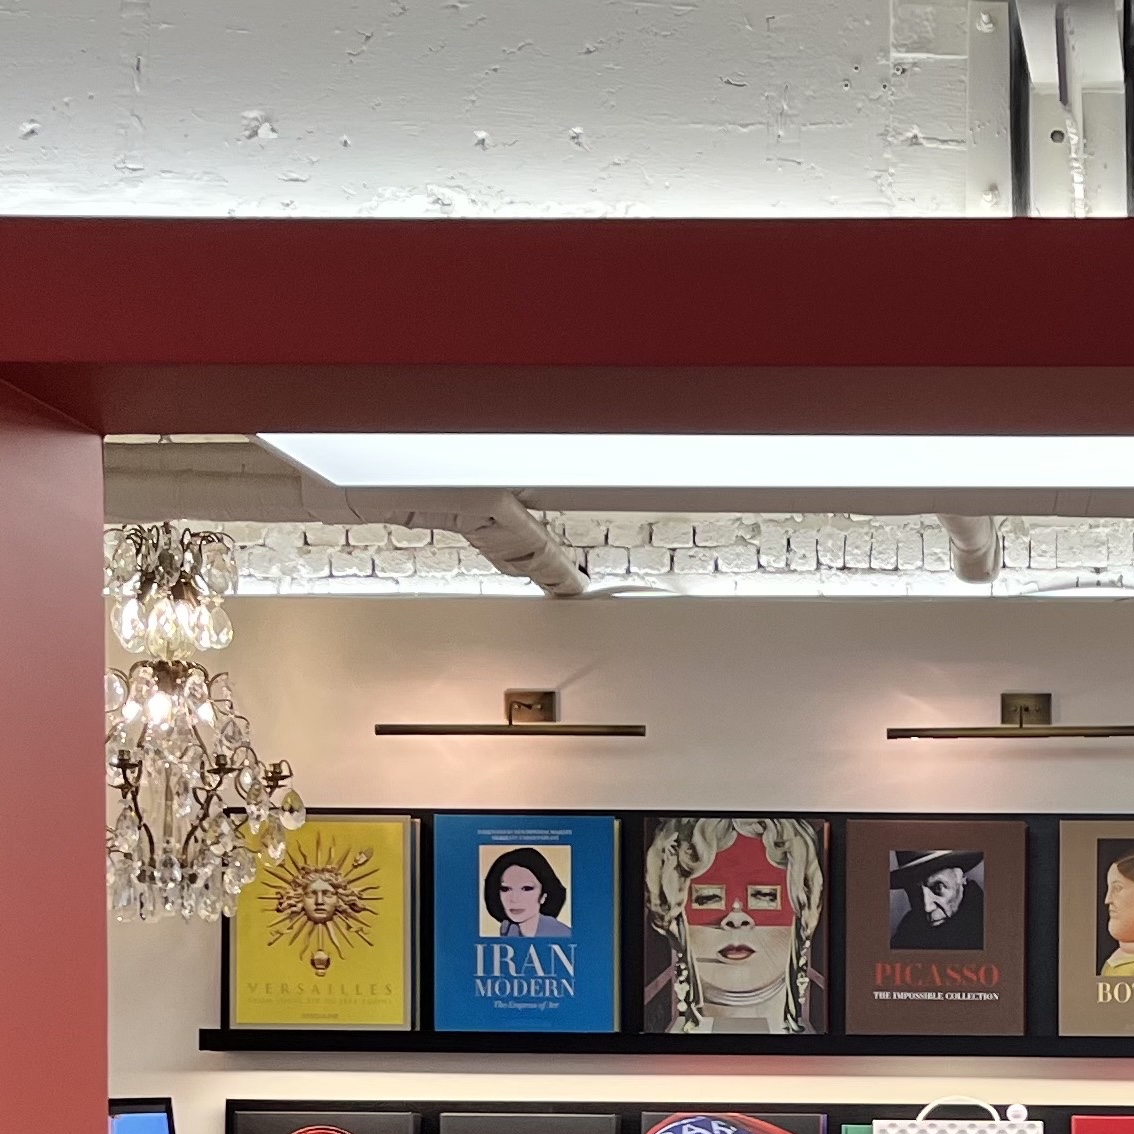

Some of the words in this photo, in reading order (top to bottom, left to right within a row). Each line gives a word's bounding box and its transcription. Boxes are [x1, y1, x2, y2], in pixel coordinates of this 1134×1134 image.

[474, 943, 578, 977] IRAN
[874, 961, 999, 987] PICASSO
[247, 982, 393, 996] VERSAILLES
[474, 979, 576, 998] MODERN
[873, 991, 891, 1000] THE
[893, 991, 943, 1001] IMPOSSIBLE
[945, 991, 999, 1001] COLLECTION
